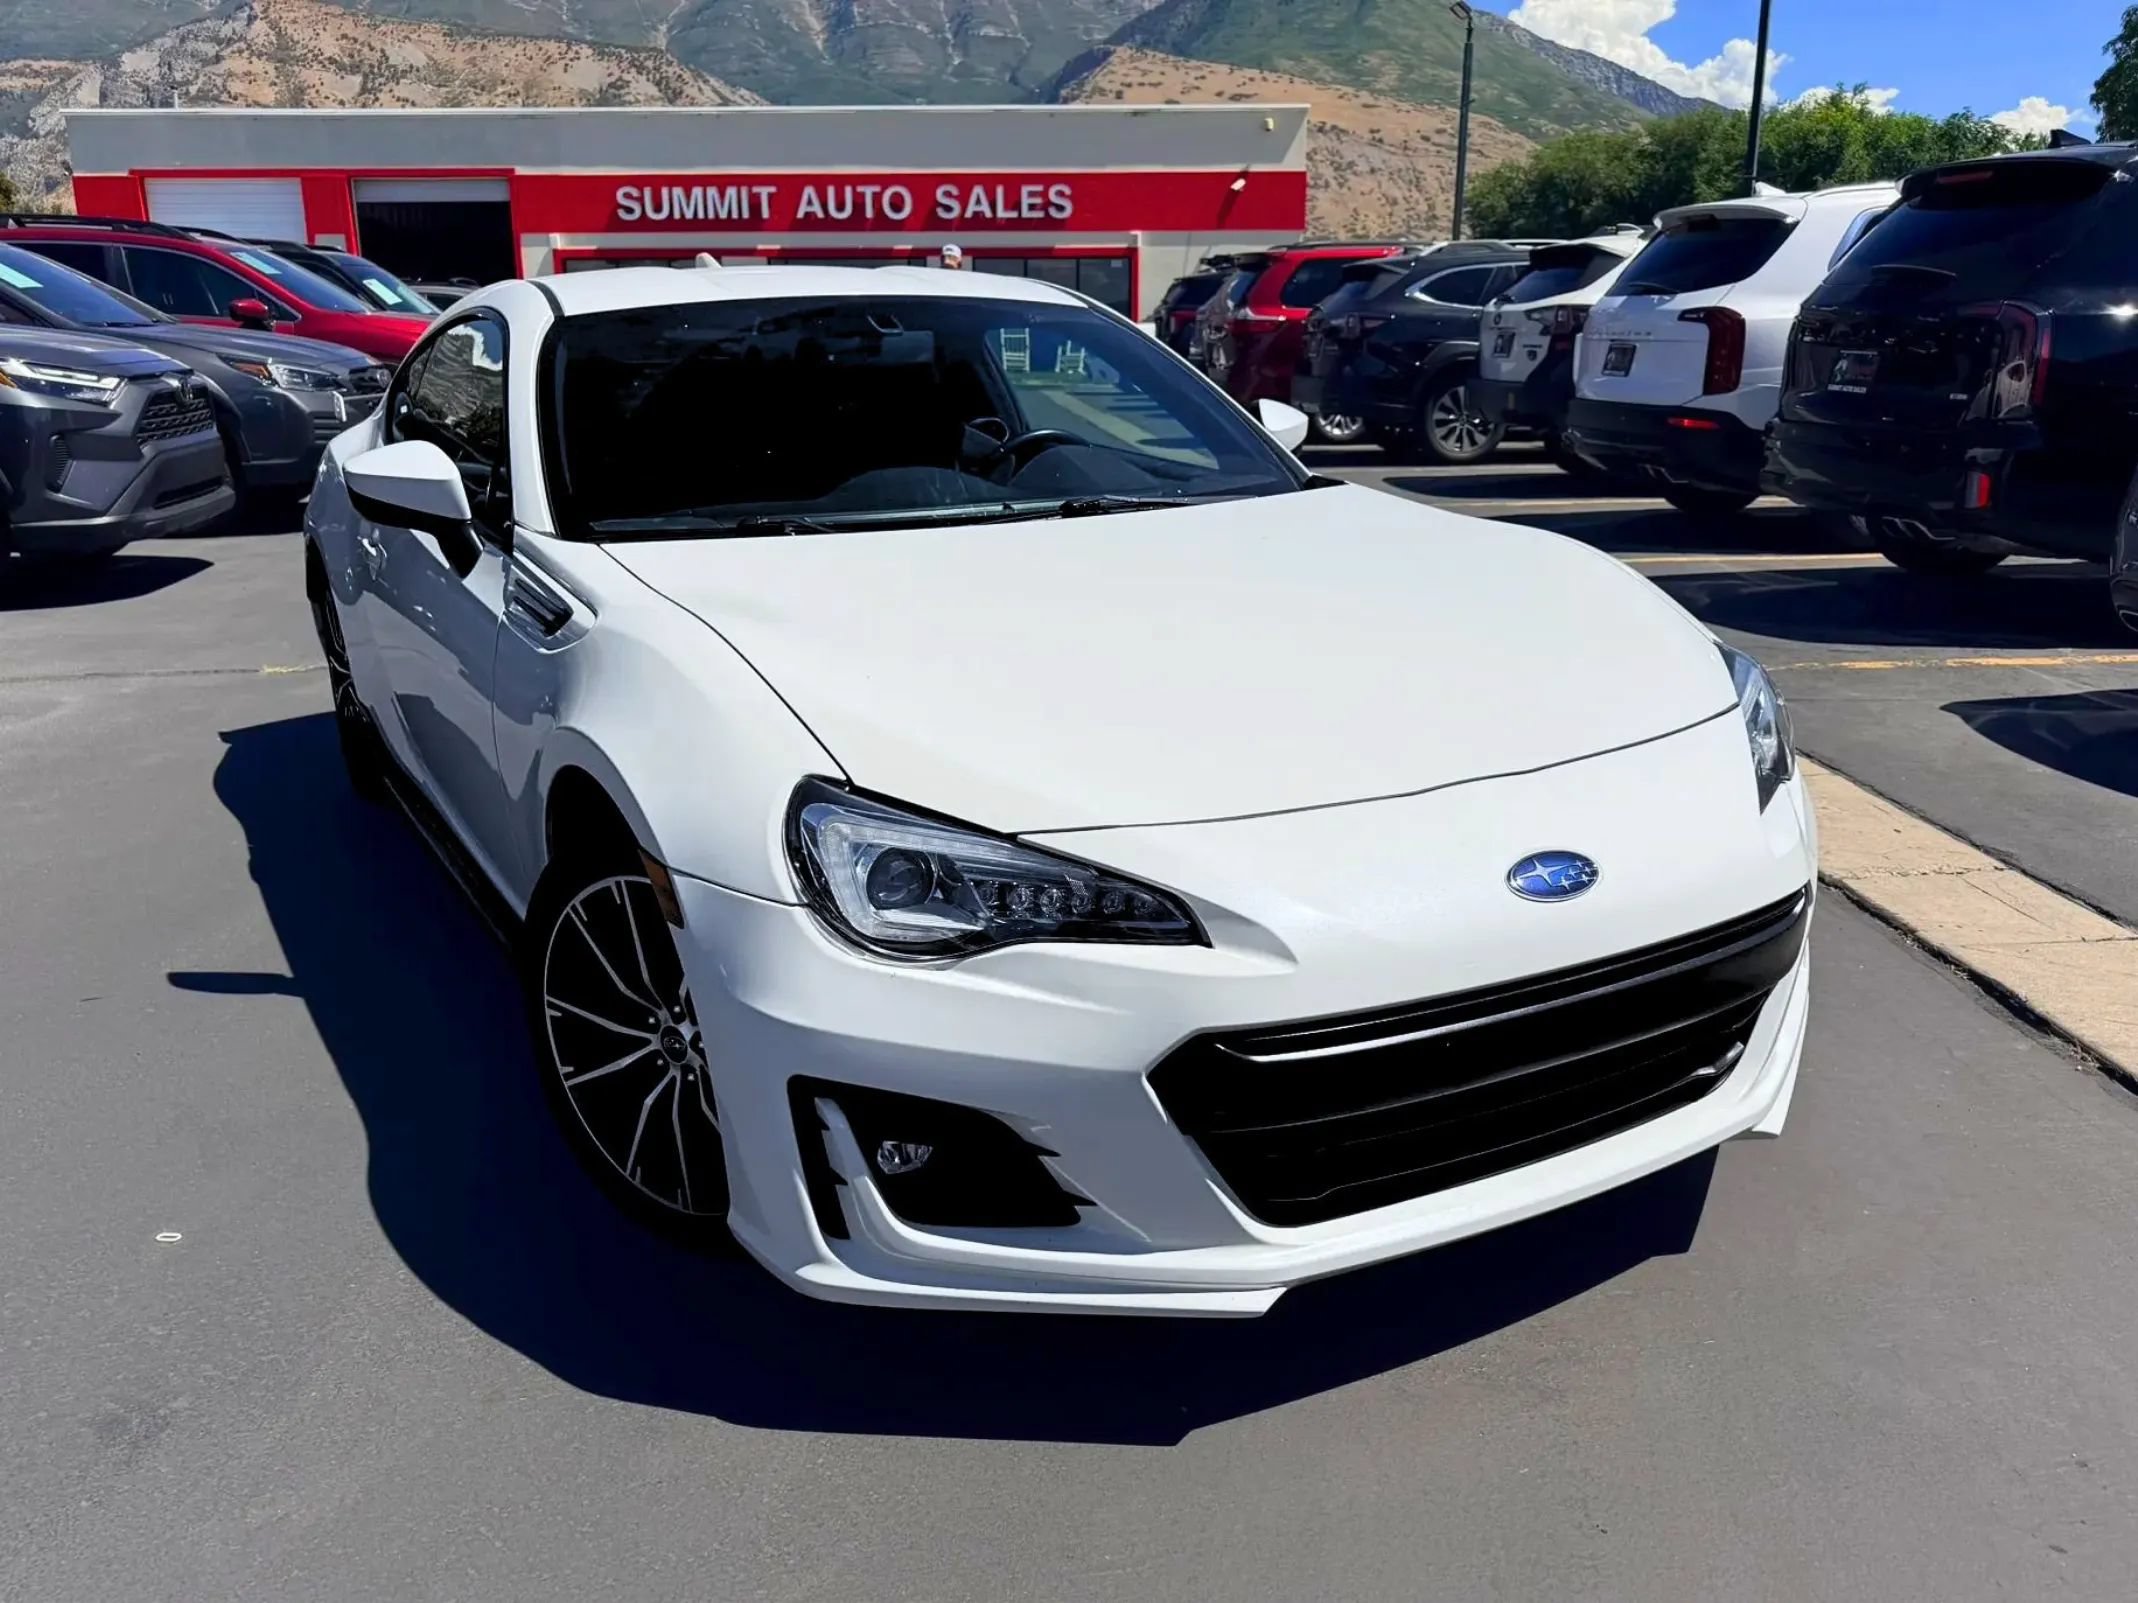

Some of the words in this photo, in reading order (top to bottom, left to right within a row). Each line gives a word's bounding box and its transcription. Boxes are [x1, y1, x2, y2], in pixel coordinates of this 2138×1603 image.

[616, 186, 777, 221] SUMMIT
[796, 185, 913, 220] AUTO
[935, 184, 1074, 220] SALES
